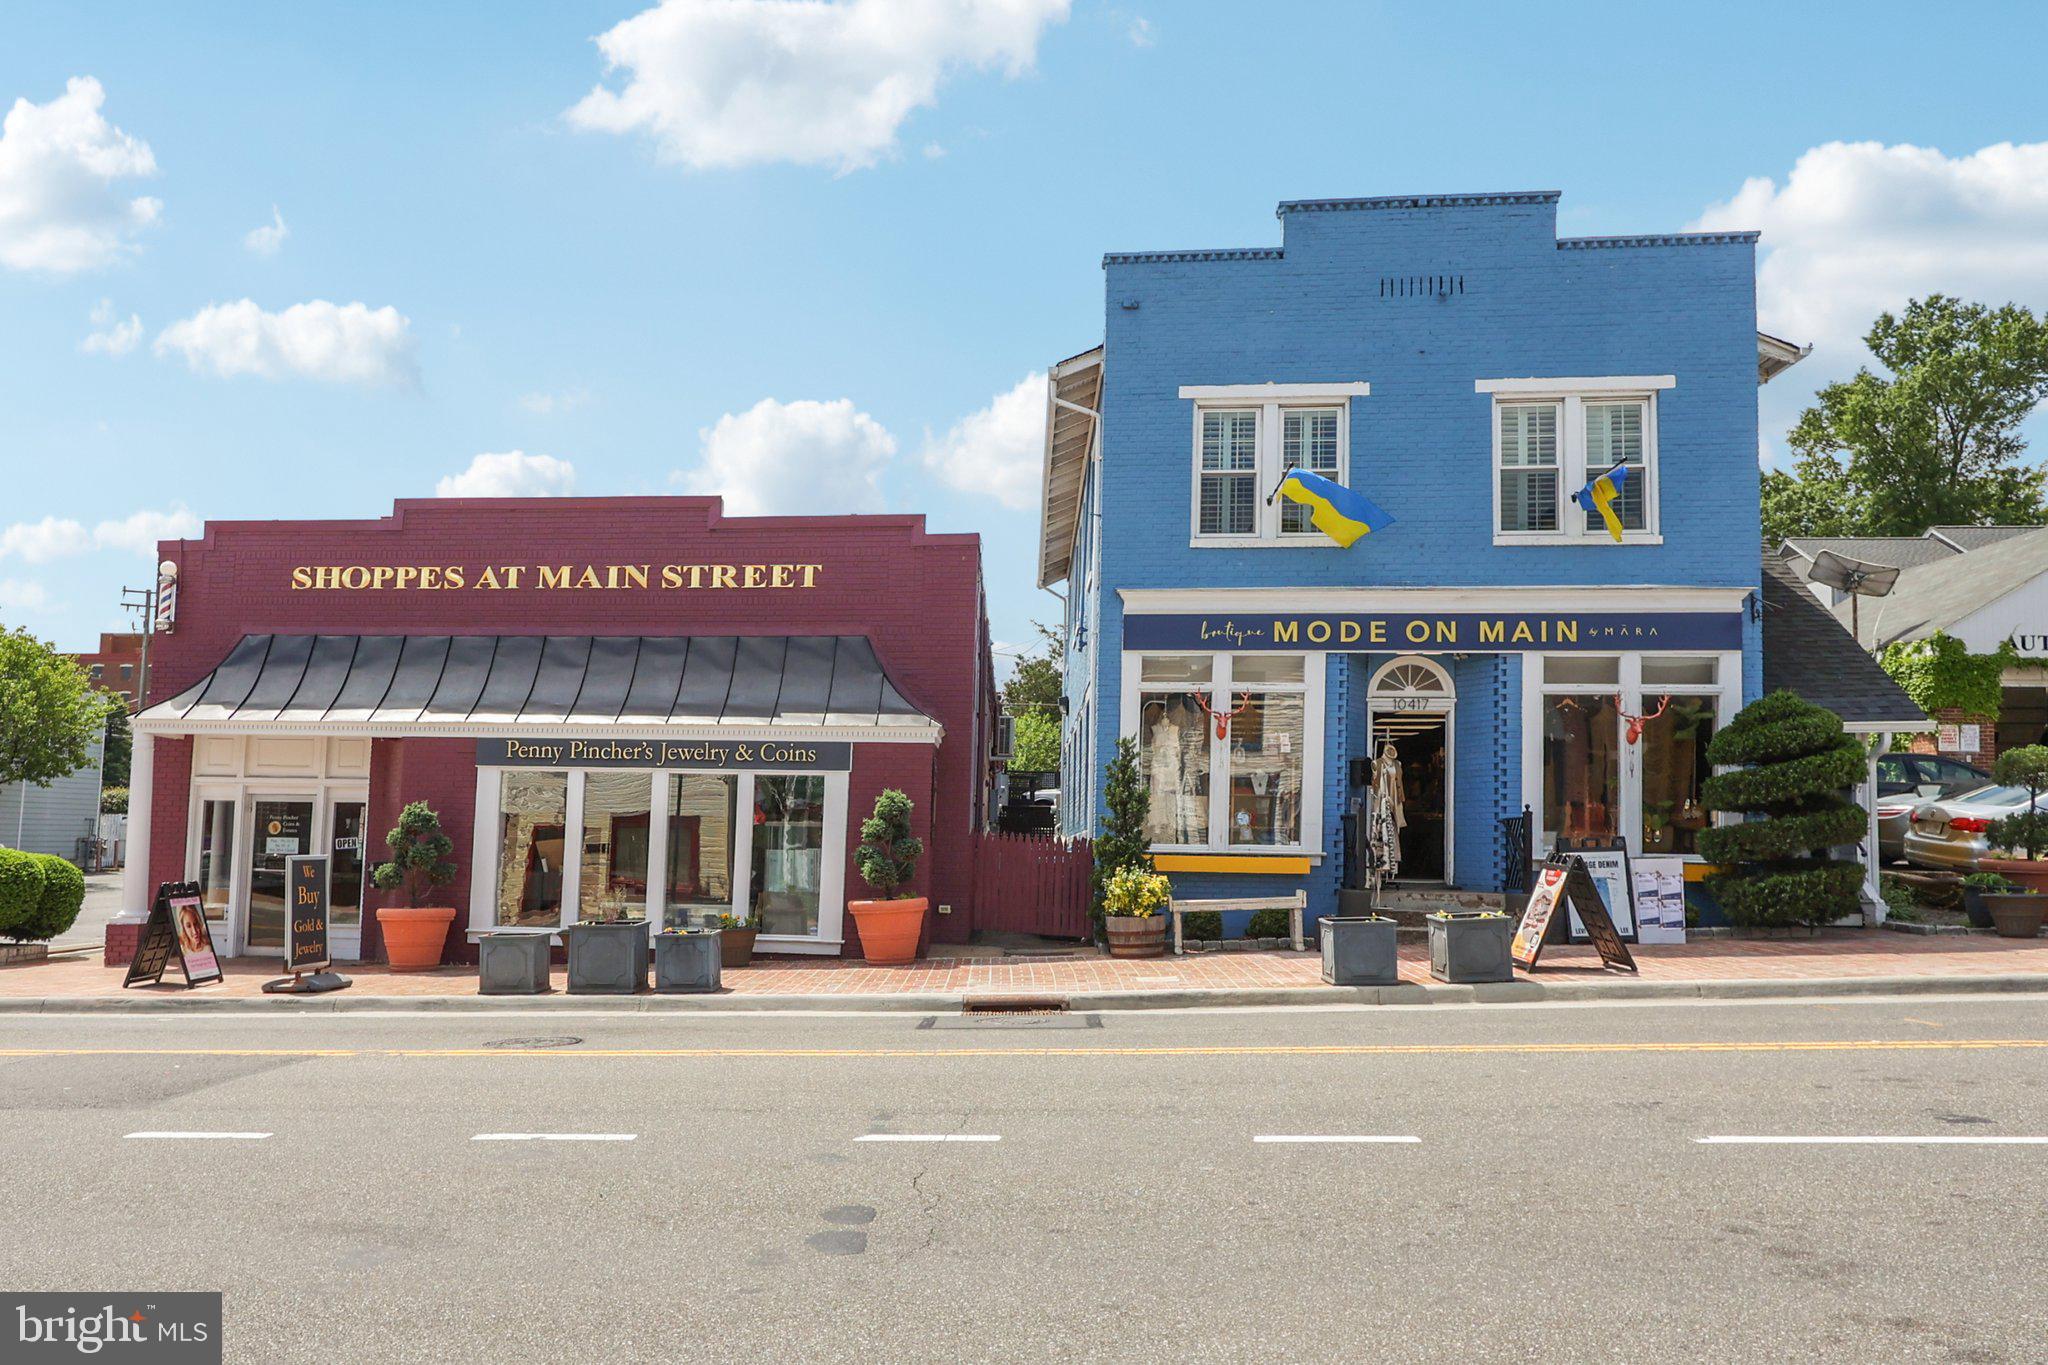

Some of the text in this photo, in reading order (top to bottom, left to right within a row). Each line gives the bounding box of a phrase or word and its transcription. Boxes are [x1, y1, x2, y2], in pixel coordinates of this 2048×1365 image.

[291, 564, 823, 590] SHOPPES AT MAIN STREET
[1200, 620, 1266, 646] boutique
[1273, 620, 1388, 643] MODE
[1405, 620, 1457, 643] ON
[1479, 620, 1578, 643] MAIN
[1392, 698, 1430, 710] 10417
[506, 740, 817, 766] Penny Pincher's Jewelry & Coins
[337, 838, 357, 849] OPEN
[302, 865, 316, 878] We
[1597, 860, 1619, 869] DENIM
[298, 886, 320, 910] Buy
[294, 919, 324, 933] Gold &
[293, 940, 324, 959] Jewelry
